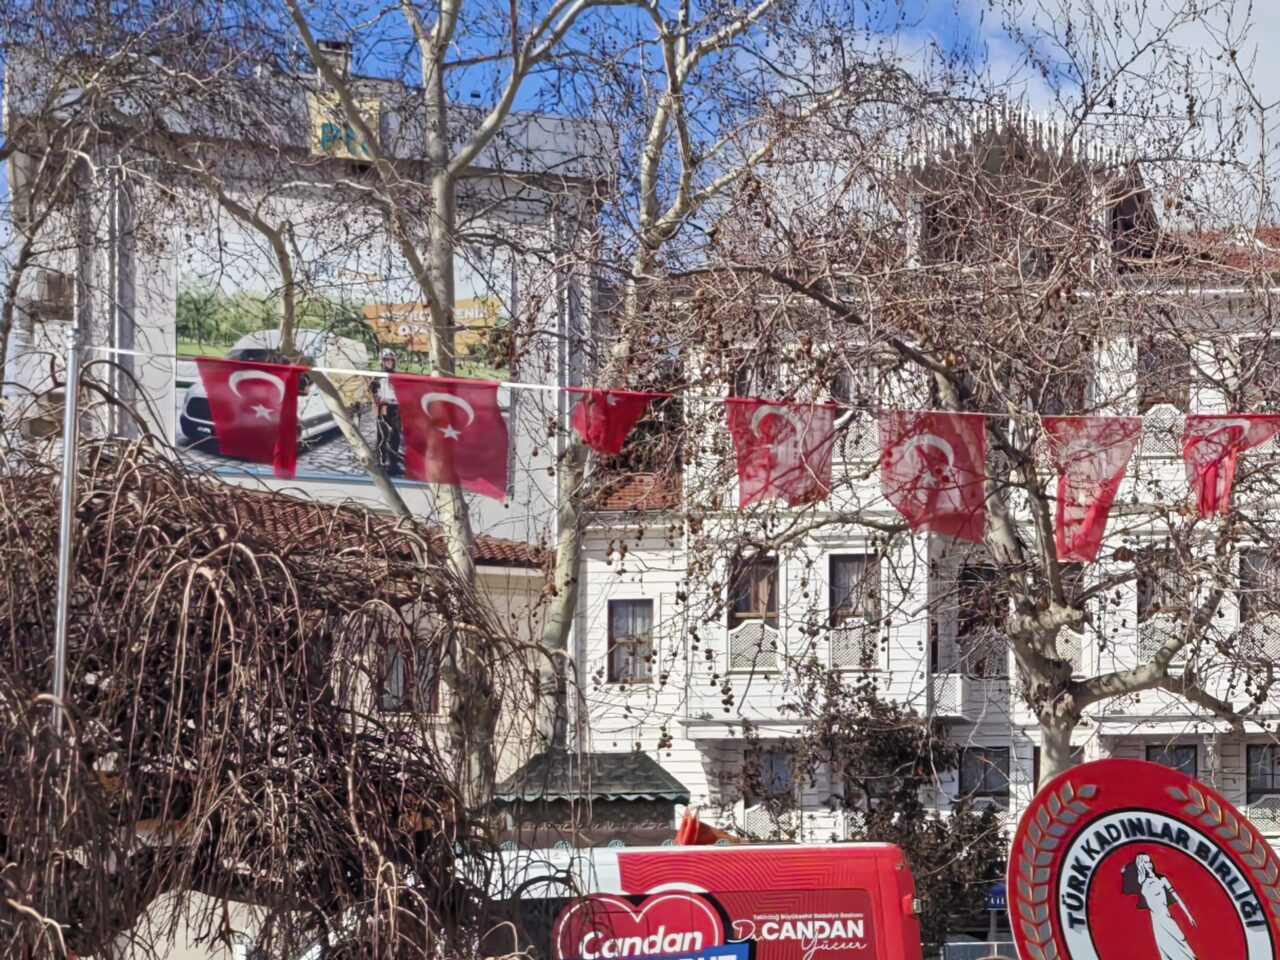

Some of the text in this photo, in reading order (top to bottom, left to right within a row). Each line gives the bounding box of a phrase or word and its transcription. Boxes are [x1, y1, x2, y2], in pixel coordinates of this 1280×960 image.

[1062, 817, 1266, 929] TÜRK KADINLAR BİRLİĞİ
[579, 925, 703, 960] Candan
[761, 919, 864, 941] CANDAN
